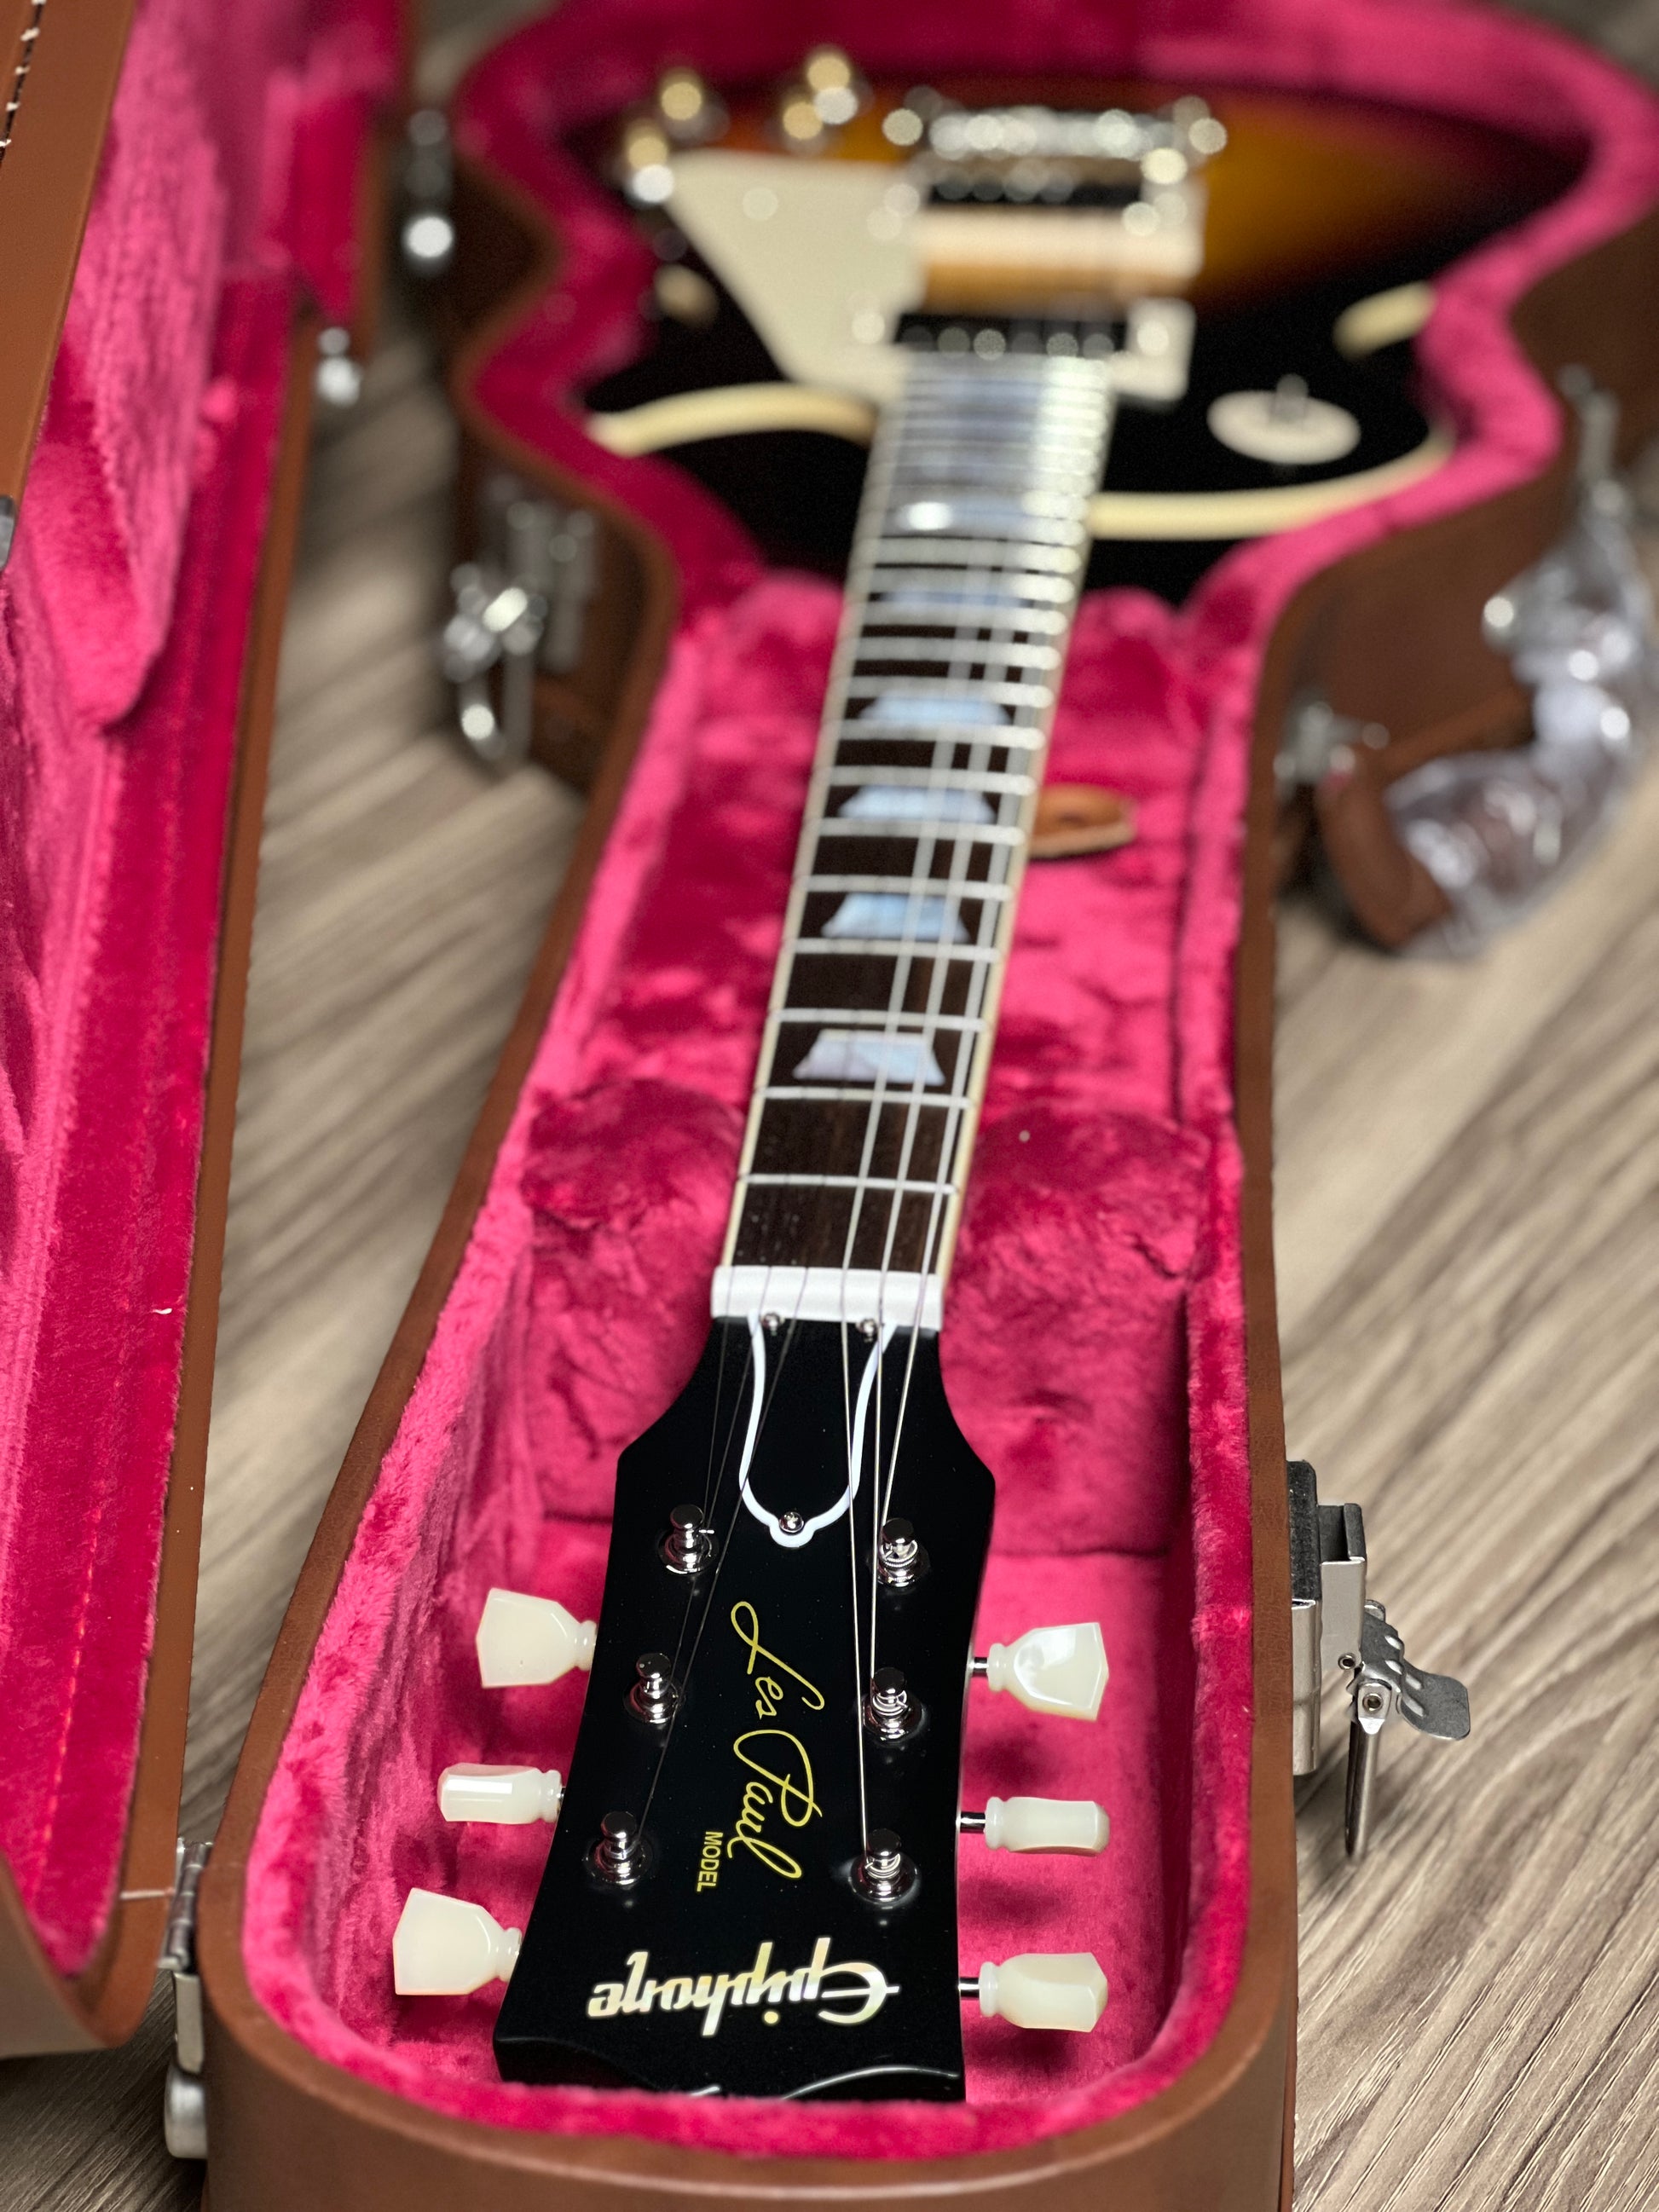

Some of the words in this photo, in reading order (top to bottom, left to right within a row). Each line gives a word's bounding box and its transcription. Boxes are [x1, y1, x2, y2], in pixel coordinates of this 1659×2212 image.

[731, 1601, 824, 1720] Les
[726, 1729, 823, 1880] Paul
[696, 1830, 724, 1892] MODEL
[587, 1937, 900, 2036] Epiphone
